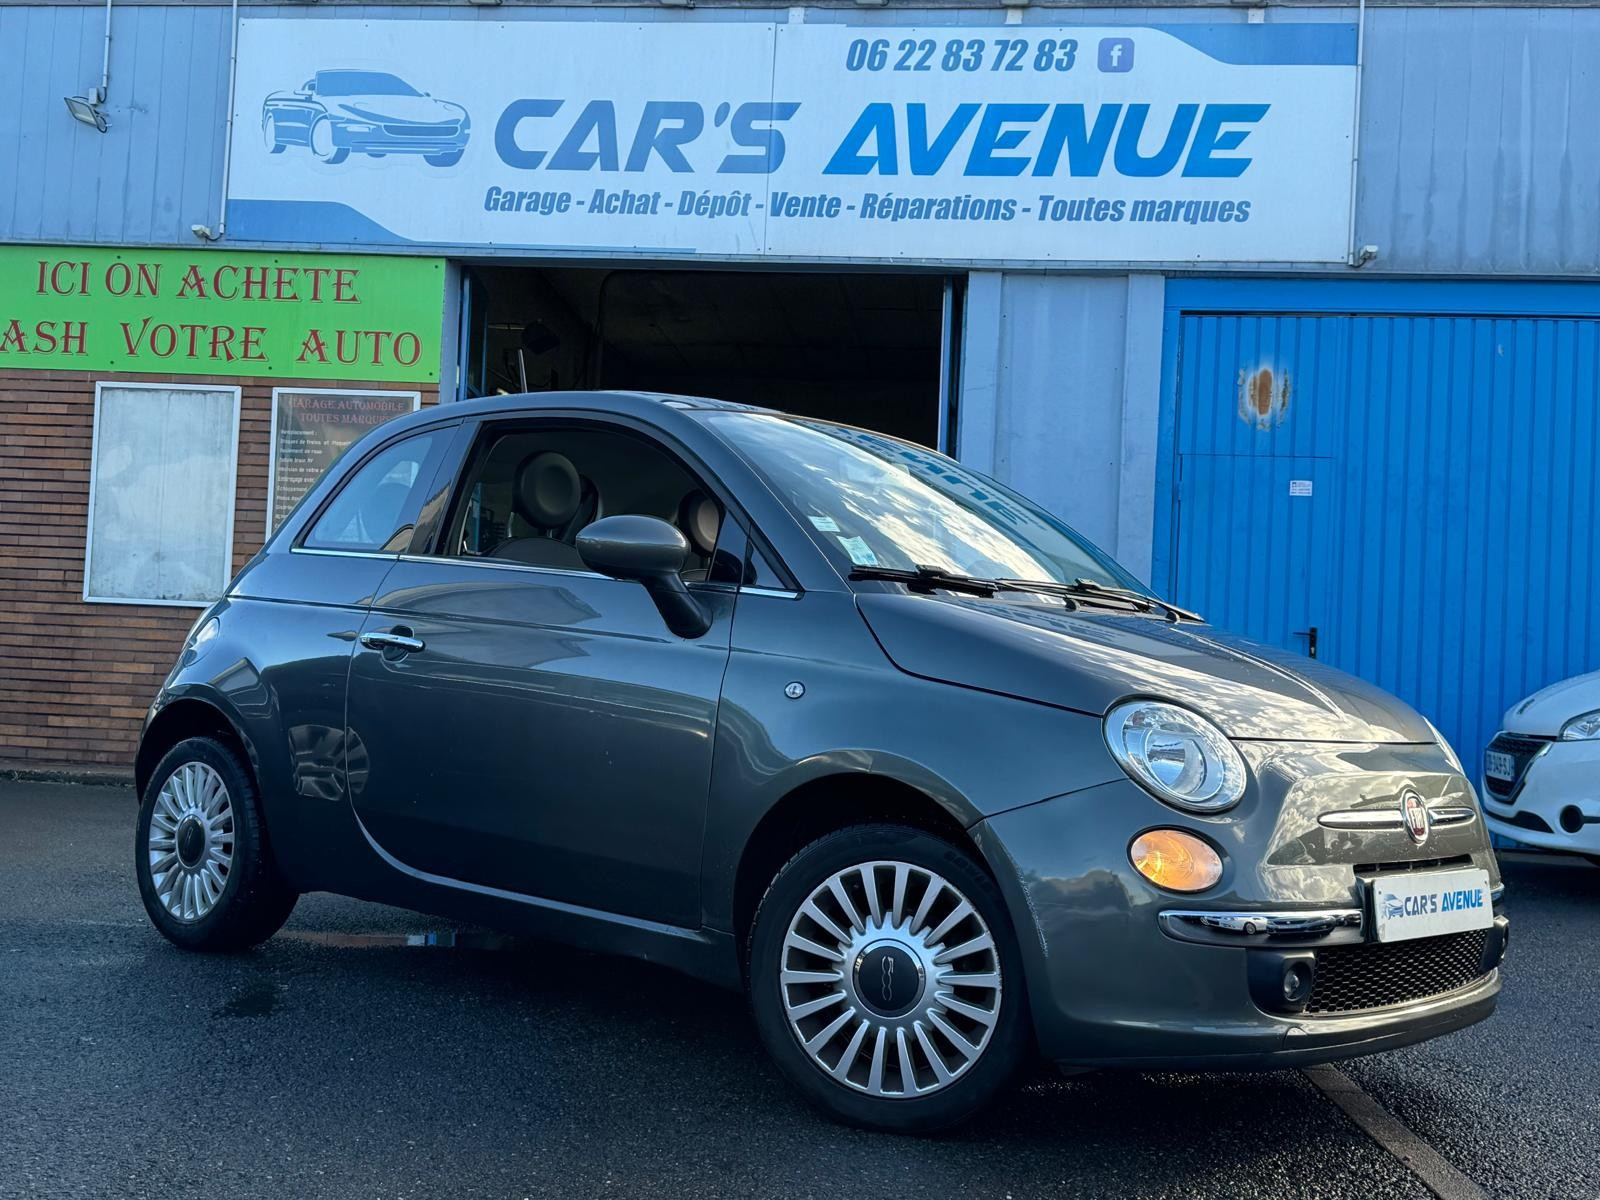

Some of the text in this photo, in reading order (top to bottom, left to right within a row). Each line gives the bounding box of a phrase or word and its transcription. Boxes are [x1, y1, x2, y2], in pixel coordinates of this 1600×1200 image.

[845, 39, 1079, 72] 06 22 83 72 83
[494, 98, 1272, 178] CAR'S AVENUE
[484, 185, 571, 216] Garage
[588, 187, 662, 216] Achat
[677, 189, 753, 219] Dépôt
[769, 191, 842, 218] Vente
[860, 192, 1018, 222] Réparations
[1037, 194, 1126, 222] Toutes
[1129, 197, 1252, 225] marques
[37, 260, 361, 303] ICI ON ACHETE
[120, 316, 269, 362] VOTRE
[296, 329, 423, 367] AUTO
[288, 397, 404, 411] GARAGE AUTOMOBILE
[300, 412, 340, 423] TOUTES
[1405, 889, 1483, 916] CAR'S AVENUE
